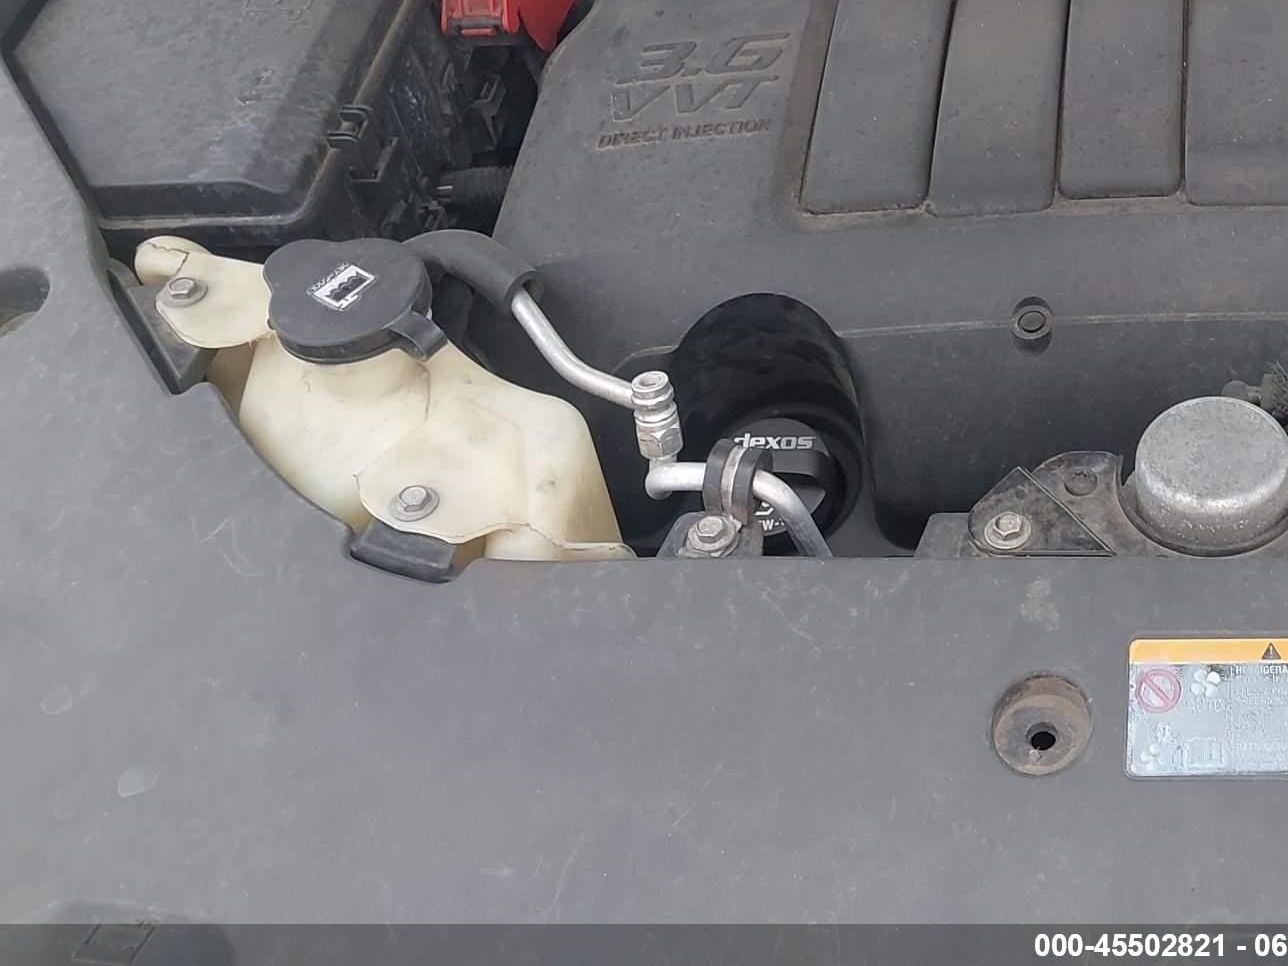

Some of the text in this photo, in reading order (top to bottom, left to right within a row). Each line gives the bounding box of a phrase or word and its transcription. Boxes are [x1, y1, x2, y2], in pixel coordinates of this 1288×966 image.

[616, 32, 791, 86] 3.6
[611, 75, 780, 124] VVT
[597, 116, 771, 150] DIRECT INJECTION
[732, 432, 817, 451] dexos
